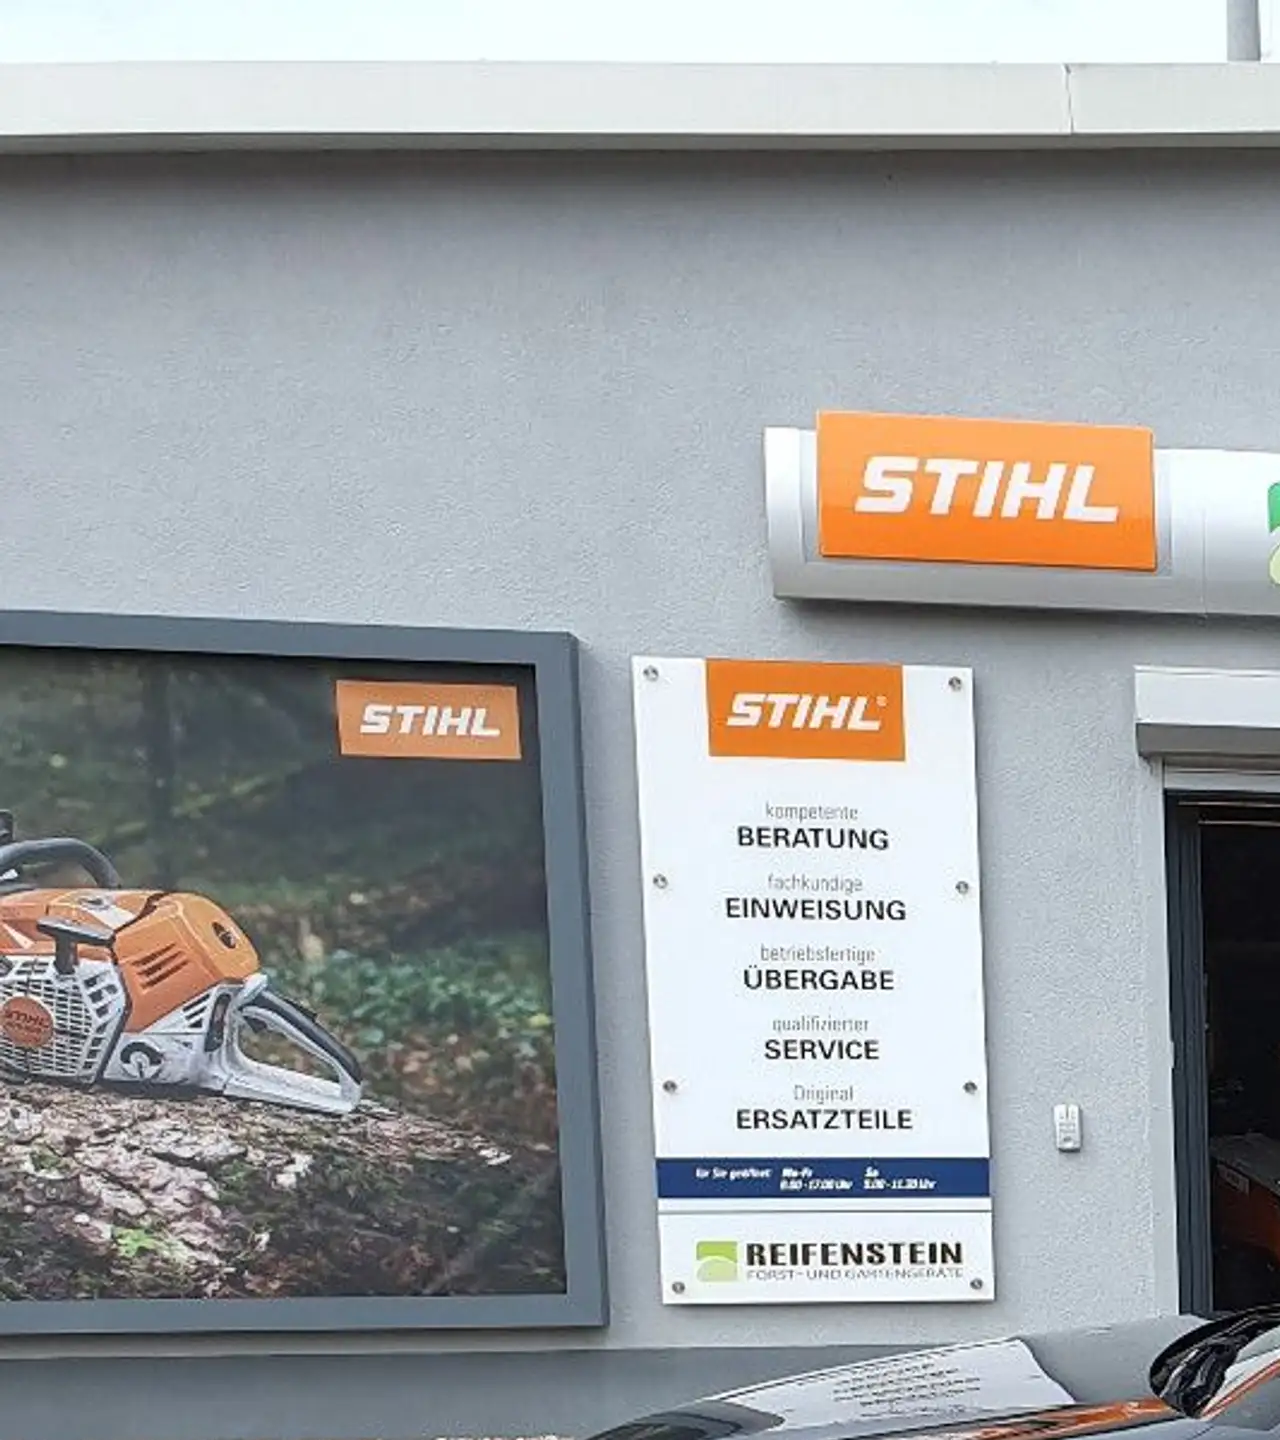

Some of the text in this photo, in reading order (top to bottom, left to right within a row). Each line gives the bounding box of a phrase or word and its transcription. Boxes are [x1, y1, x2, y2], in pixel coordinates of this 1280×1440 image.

[856, 455, 1118, 523] STIHL
[360, 704, 500, 738] STIHL
[765, 802, 858, 824] kompetente
[737, 826, 889, 851] BERATUNG
[767, 873, 863, 896] fachkundige
[726, 897, 906, 921] EINWEISUNG
[760, 944, 876, 966] betriebsfertige
[744, 965, 894, 990] ÜBERGABE
[772, 1015, 869, 1033] qualifizierter
[765, 1039, 879, 1060] SERVICE
[794, 1084, 854, 1105] Original
[737, 1108, 914, 1130] ERSATZTEILE
[746, 1242, 963, 1266] REIFENSTEIN
